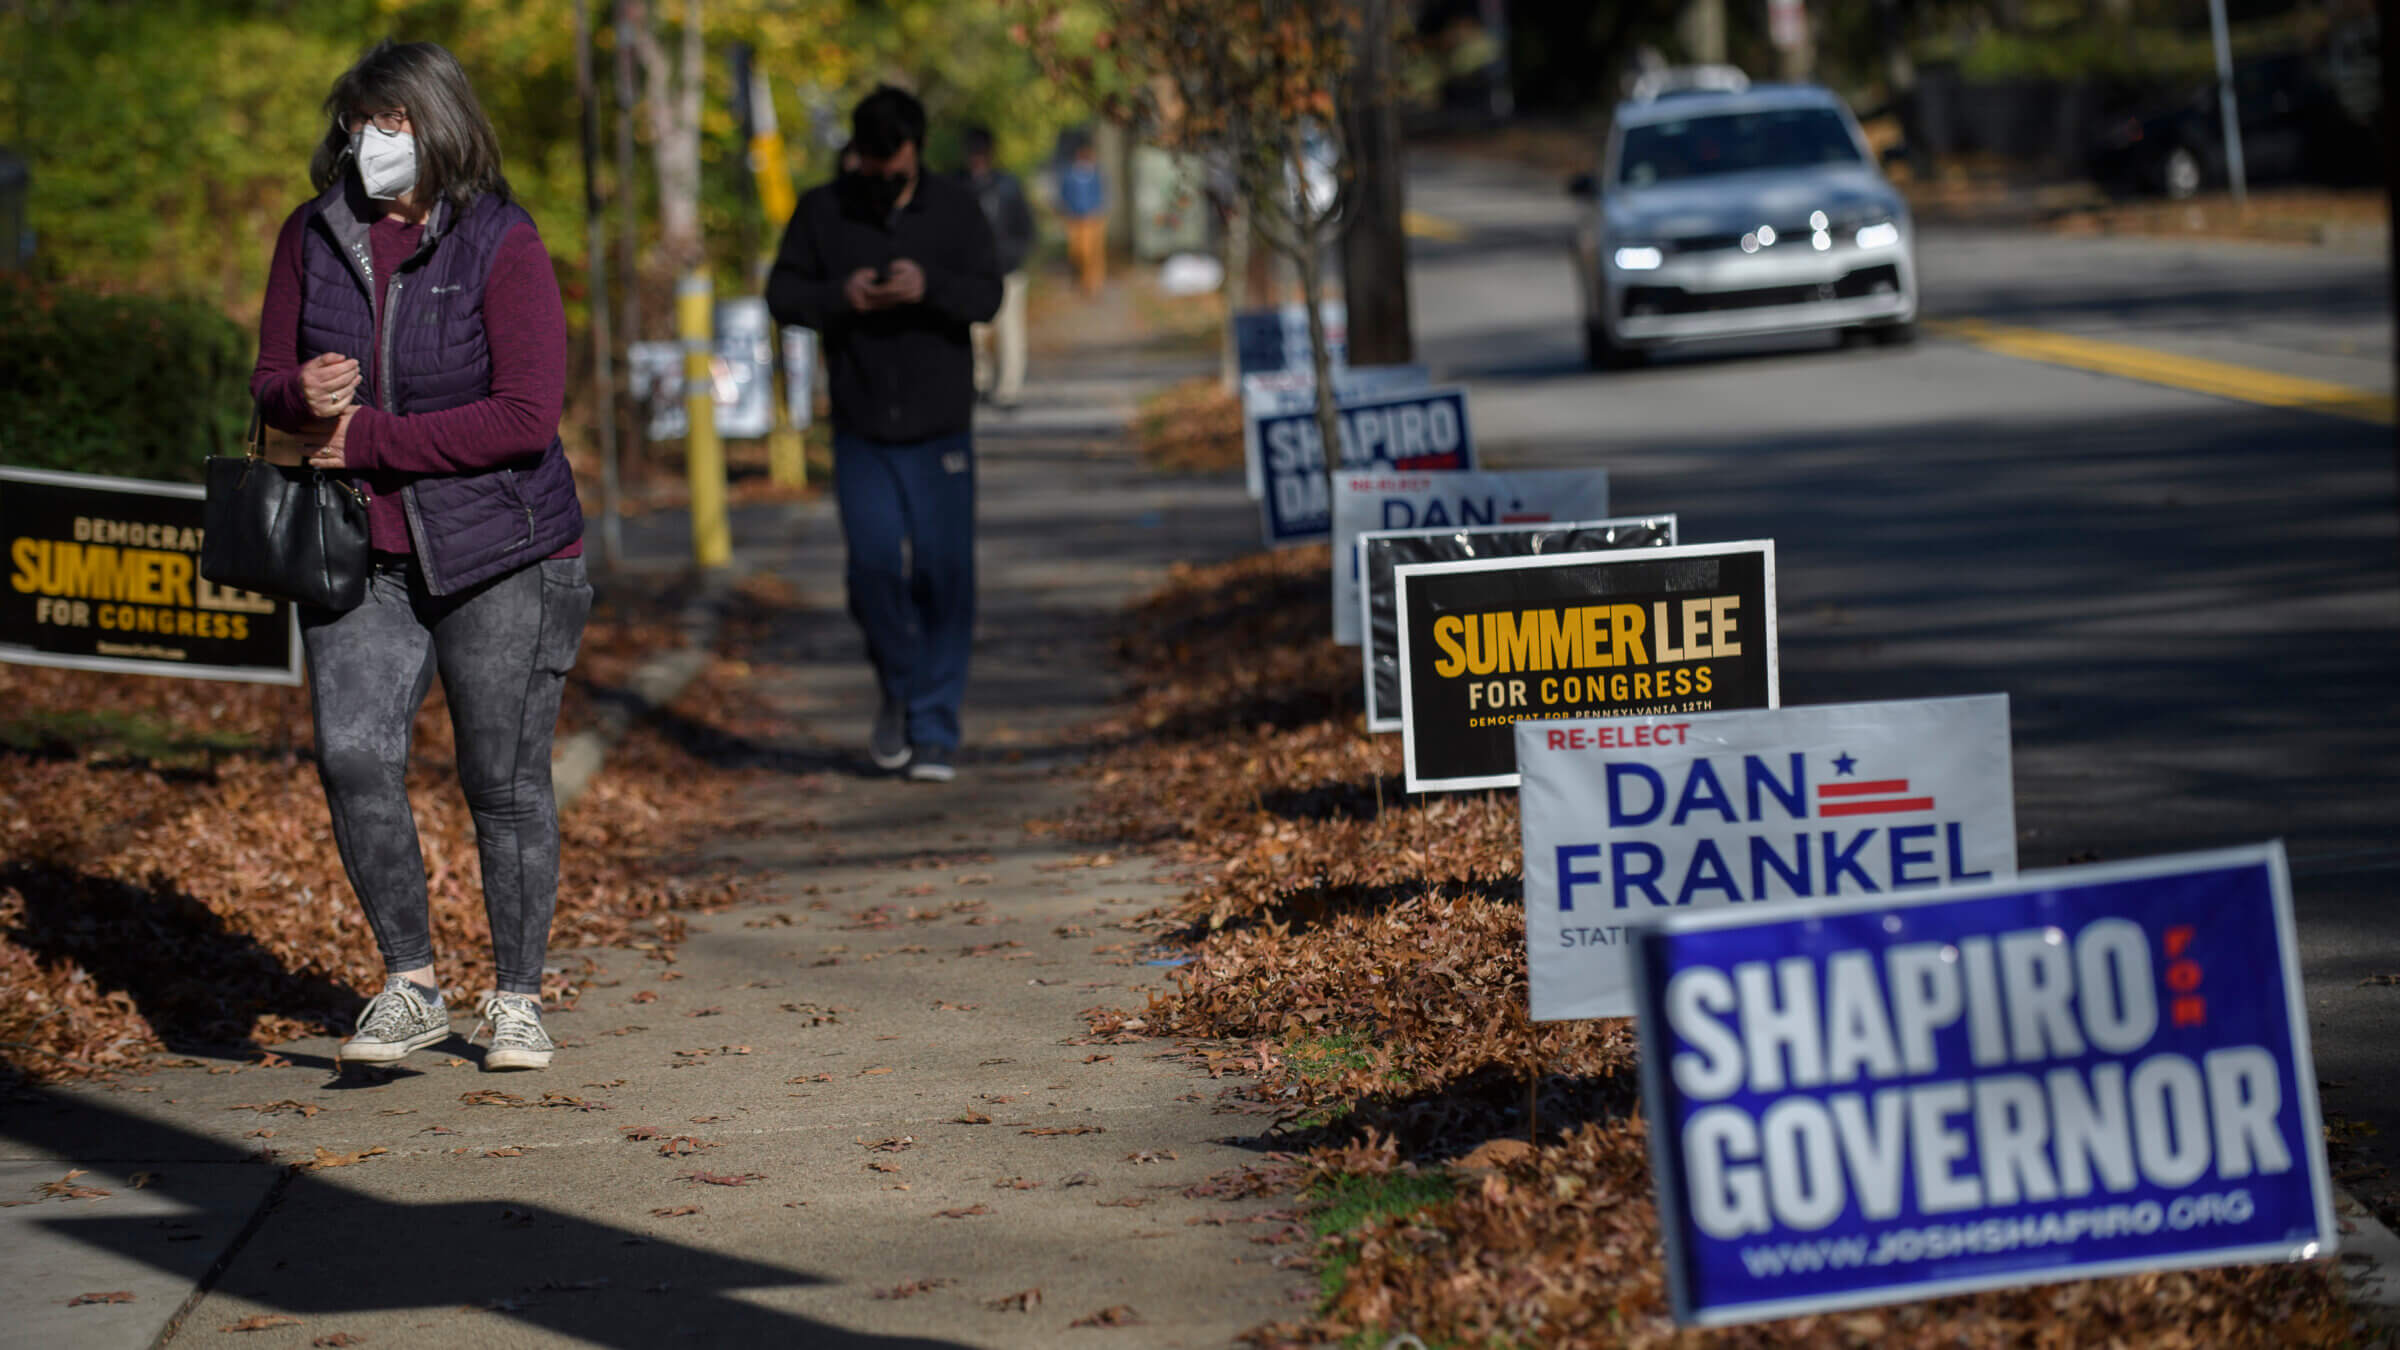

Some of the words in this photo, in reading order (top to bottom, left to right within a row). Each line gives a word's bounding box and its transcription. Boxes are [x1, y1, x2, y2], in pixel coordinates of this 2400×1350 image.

[10, 536, 193, 608] SUMMER
[36, 597, 90, 628] FOR
[97, 604, 249, 640] CONGRESS
[1433, 603, 1648, 678] SUMMER
[1653, 595, 1742, 663] LEE
[1469, 680, 1528, 711] FOR
[1540, 666, 1713, 705] CONGRESS
[1470, 712, 1540, 728] DEMOCRAT
[1575, 704, 1677, 719] PENNSYLVANIA
[1682, 700, 1712, 713] 12TH
[1547, 723, 1690, 750] RE-ELECT
[1605, 753, 1808, 828] DAN
[1556, 822, 1991, 911] FRANKEL
[1665, 917, 2158, 1101] SHAPIRO
[1681, 1045, 2291, 1239] GOVERNOR
